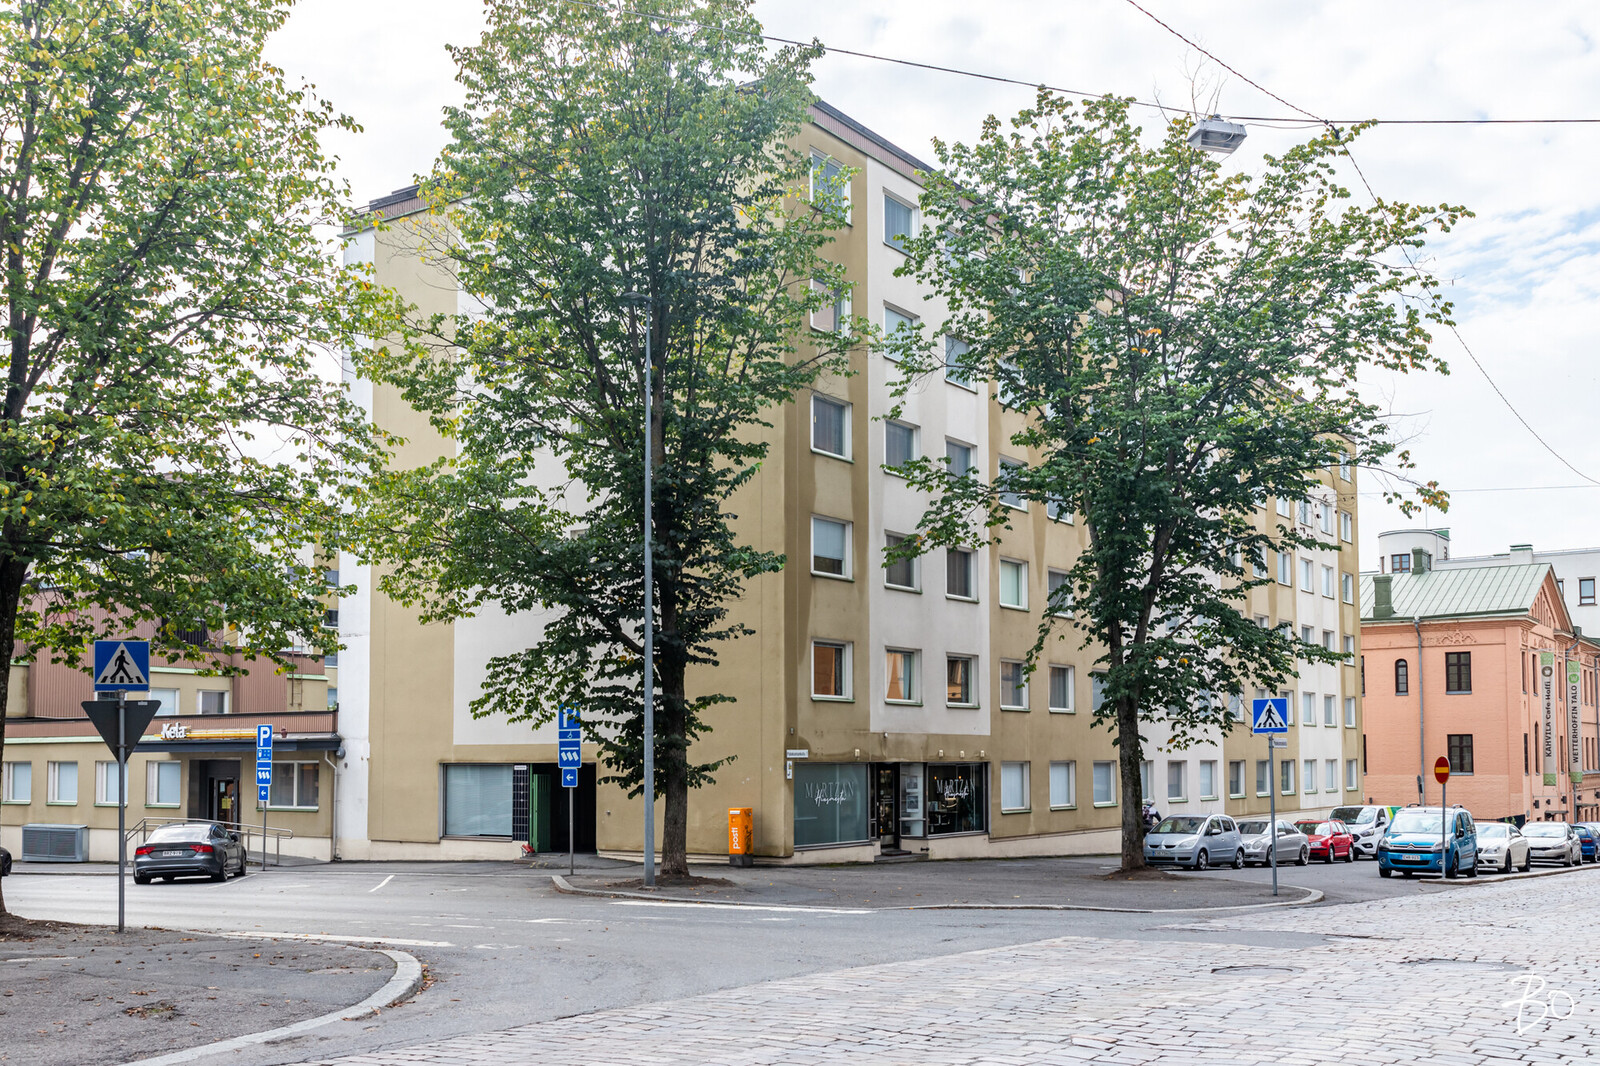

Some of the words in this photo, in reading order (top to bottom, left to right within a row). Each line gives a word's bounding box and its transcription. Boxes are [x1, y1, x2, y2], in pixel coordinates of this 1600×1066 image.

[161, 722, 187, 738] Kela
[260, 727, 270, 746] P
[1571, 706, 1579, 763] WETTERHOFFIN
[805, 781, 854, 799] MARTZAN
[936, 779, 976, 794] MARTZAN
[731, 827, 741, 849] posti
